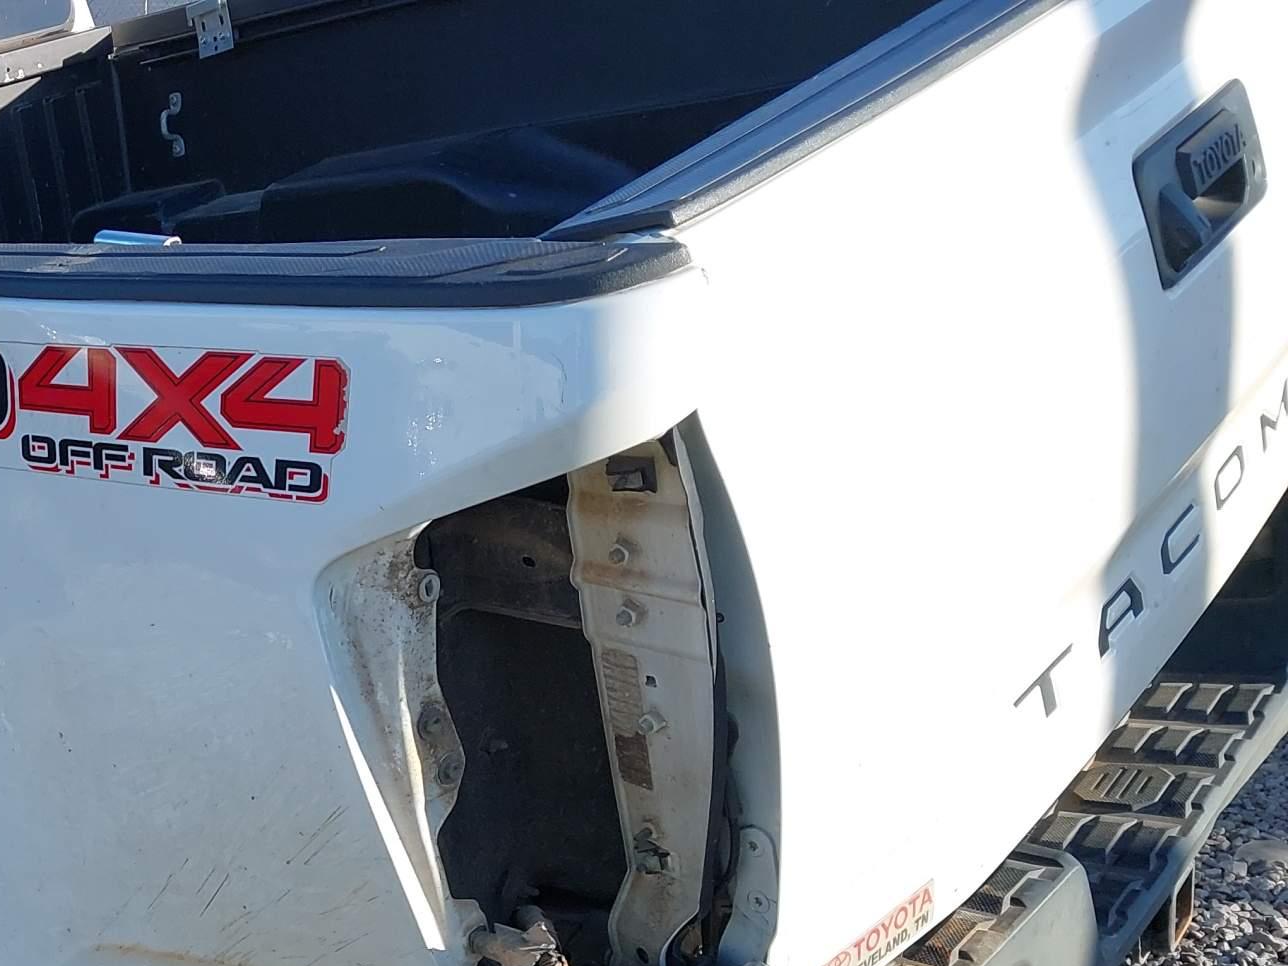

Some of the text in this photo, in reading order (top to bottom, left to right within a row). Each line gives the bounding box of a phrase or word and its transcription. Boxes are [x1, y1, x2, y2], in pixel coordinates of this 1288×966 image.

[1192, 124, 1247, 186] TOYOTA
[17, 344, 349, 454] 4X4
[20, 433, 330, 504] OFF ROAD
[854, 887, 933, 961] TOYOTA
[914, 910, 929, 931] TN
